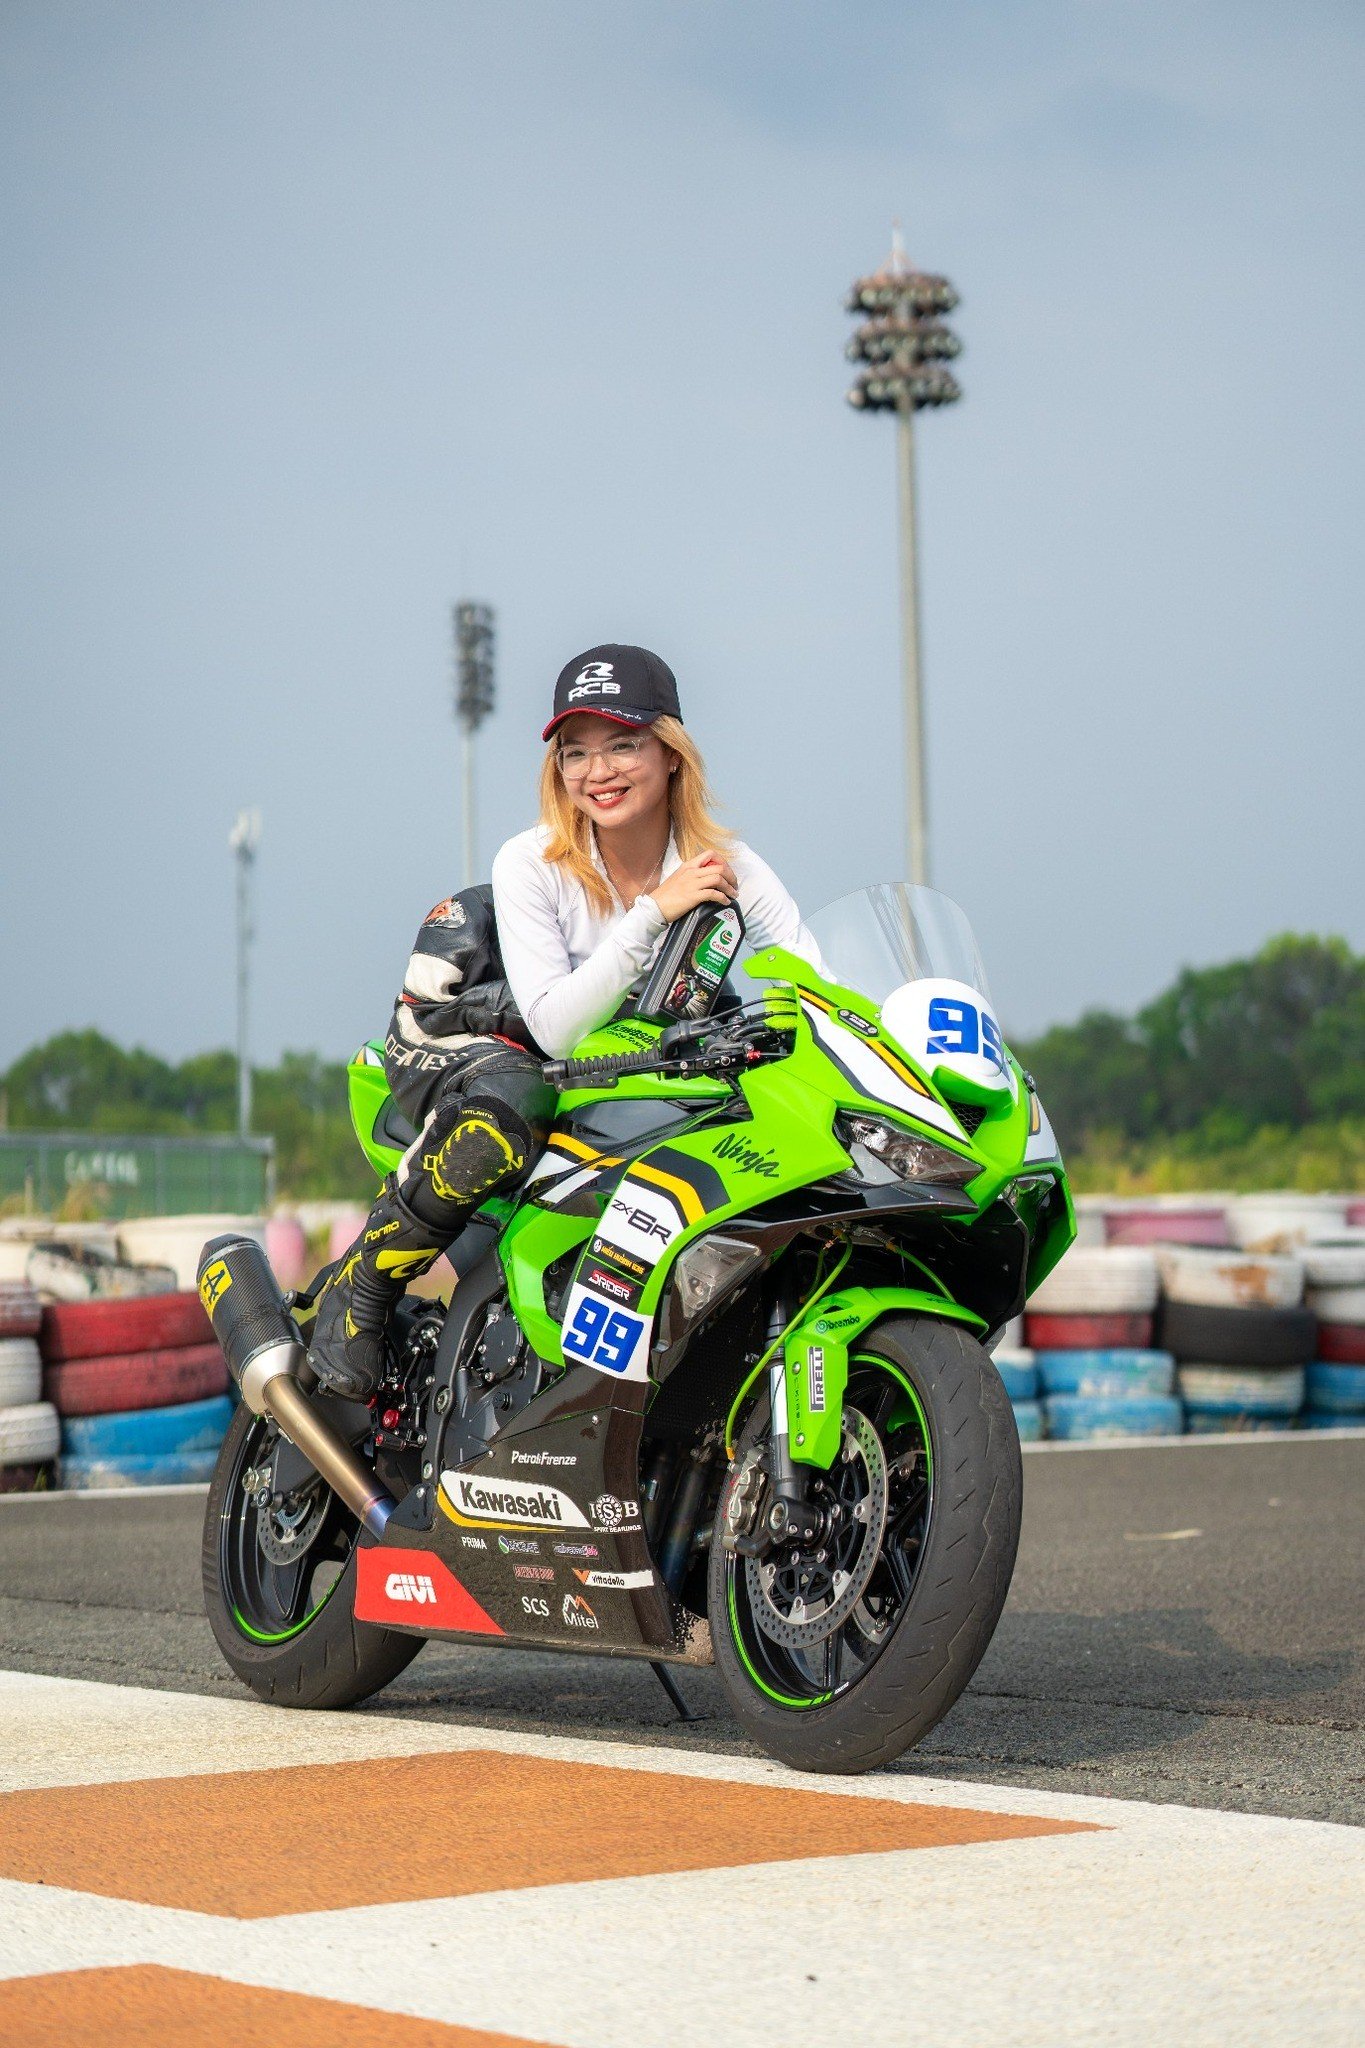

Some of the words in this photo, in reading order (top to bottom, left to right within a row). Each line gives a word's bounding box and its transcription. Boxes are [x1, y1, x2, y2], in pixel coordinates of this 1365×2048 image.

[568, 682, 621, 702] RCB
[711, 1132, 780, 1178] Ninja
[611, 1199, 673, 1246] ZX-6R
[562, 1296, 645, 1373] 99
[827, 1315, 861, 1330] brembo
[808, 1346, 825, 1412] PIRELLI
[459, 1480, 562, 1521] Kawasaki
[461, 1536, 488, 1550] PRIMA
[385, 1573, 438, 1605] GIVI
[521, 1596, 550, 1617] SCS
[562, 1611, 600, 1629] Mitel
